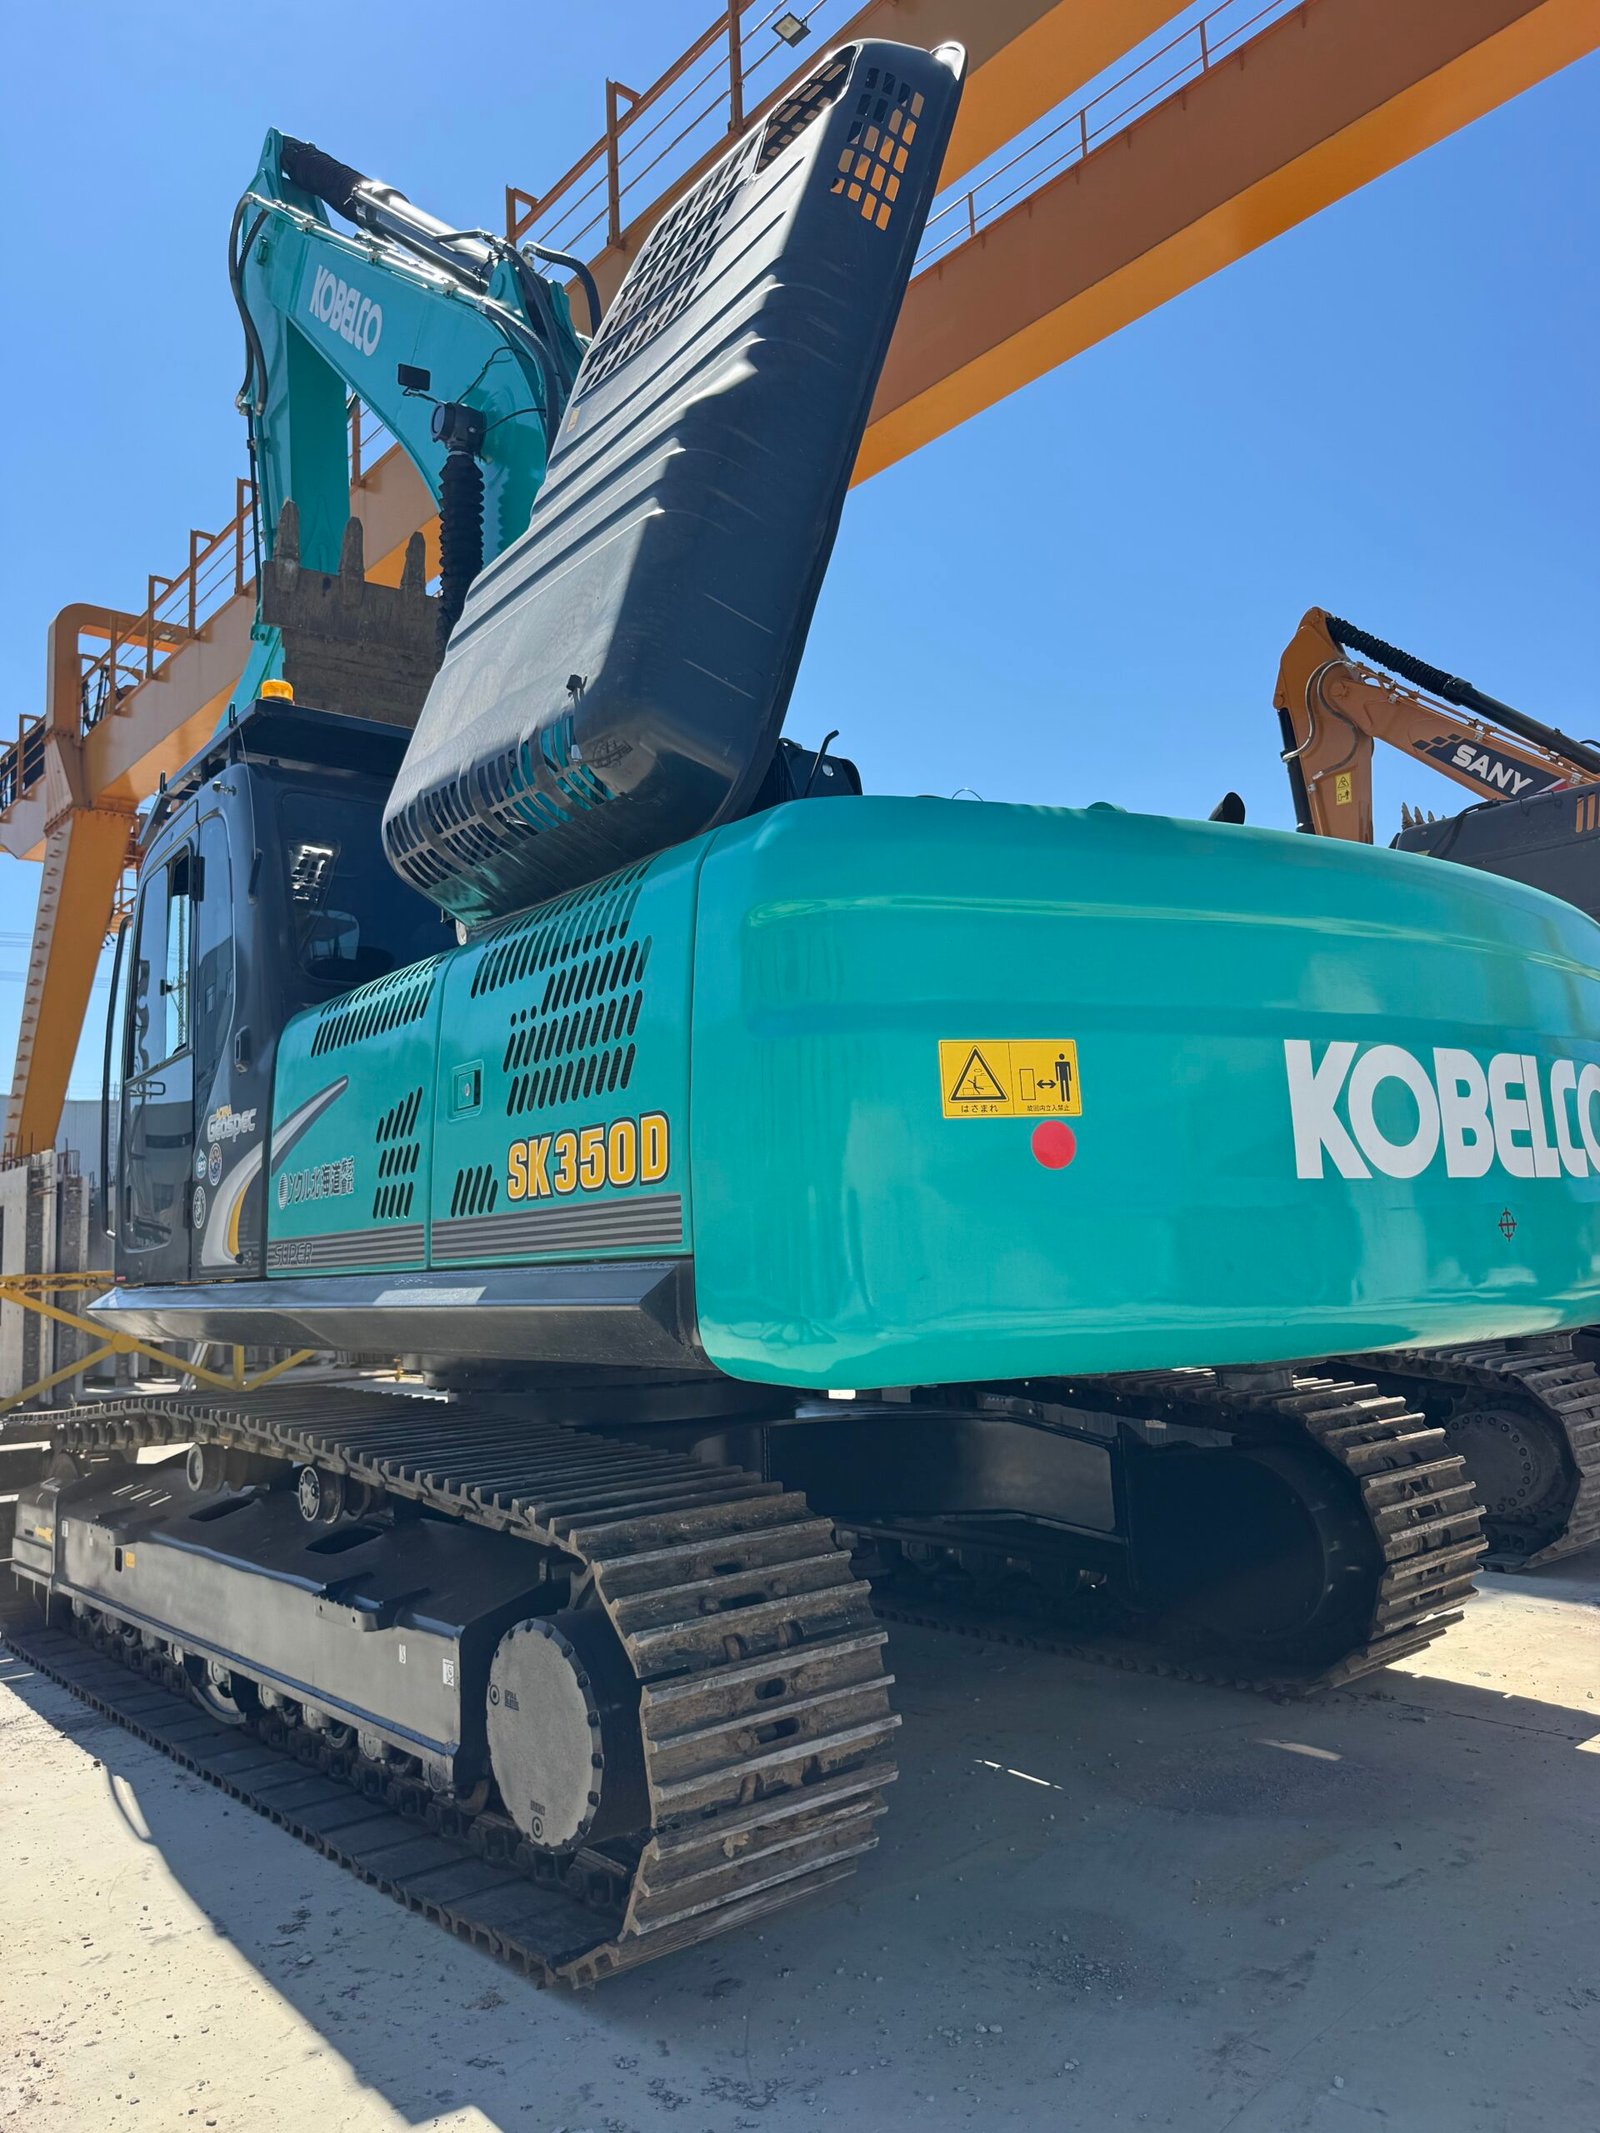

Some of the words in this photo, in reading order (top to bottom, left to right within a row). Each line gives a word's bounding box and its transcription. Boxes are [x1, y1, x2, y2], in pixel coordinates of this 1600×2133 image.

[309, 263, 382, 356] KOBELCO
[1451, 744, 1533, 795] SANY
[961, 1104, 999, 1113] はさまれ
[508, 1110, 670, 1202] SK350D
[275, 1242, 313, 1266] SUPER
